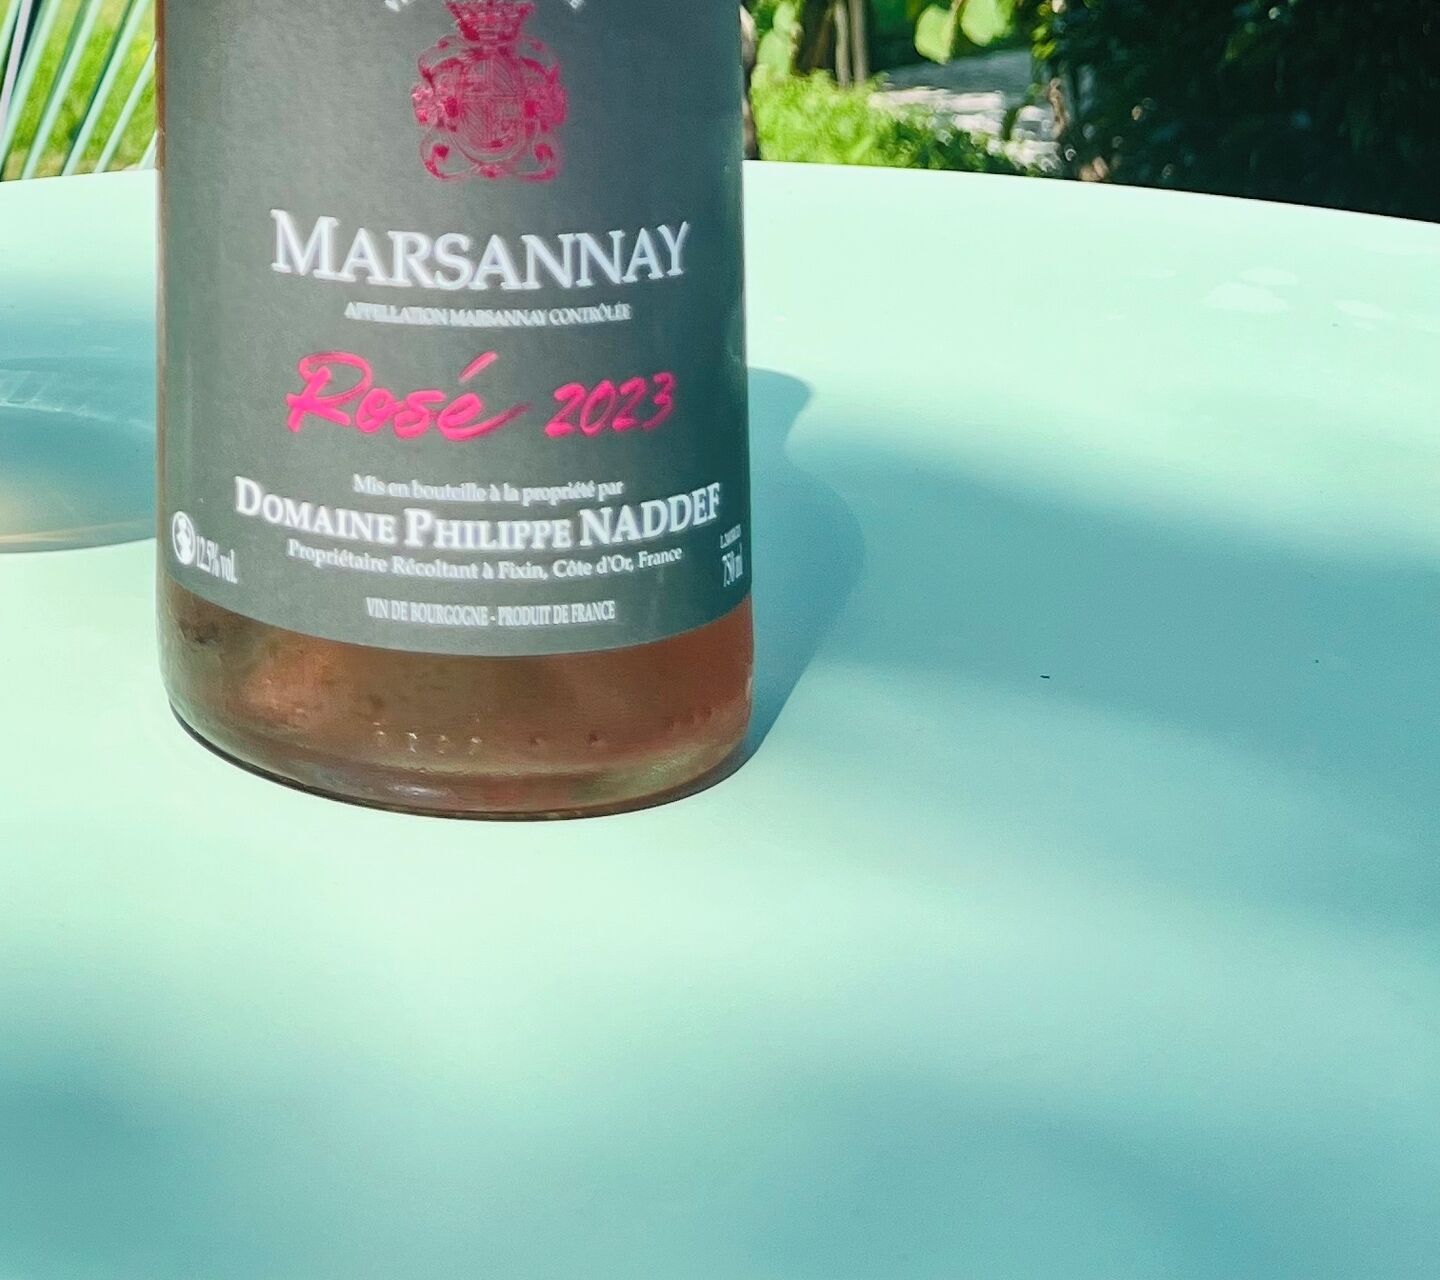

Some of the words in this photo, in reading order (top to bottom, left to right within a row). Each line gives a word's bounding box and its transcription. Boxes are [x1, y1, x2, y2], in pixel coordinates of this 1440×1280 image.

[269, 209, 690, 291] MARSANNAY
[344, 301, 449, 326] APPELLATION
[449, 307, 547, 328] MARSANNAY
[548, 300, 633, 326] CONTRÔLÉE
[285, 350, 531, 441] Rosé
[543, 371, 677, 438] 2023
[352, 473, 386, 496] Mis
[387, 481, 409, 498] en
[411, 479, 487, 502] bouteille
[489, 482, 502, 502] à
[503, 481, 520, 502] la
[521, 480, 596, 507] propriété
[597, 480, 624, 502] par
[234, 475, 397, 545] DOMAINE
[403, 507, 573, 551] PHILIPPE
[578, 481, 721, 547] NADDEF
[286, 538, 389, 574] Propriétaire
[391, 554, 479, 580] Récoltant
[480, 561, 495, 580] à
[497, 560, 549, 581] Fixin,
[552, 558, 593, 579] Côte
[637, 546, 684, 570] France
[366, 597, 392, 619] VIN
[391, 599, 410, 622] DE
[410, 601, 490, 627] BOURGOGNE
[497, 604, 551, 627] PRODUIT
[552, 603, 570, 625] DE
[571, 599, 617, 624] FRANCE
